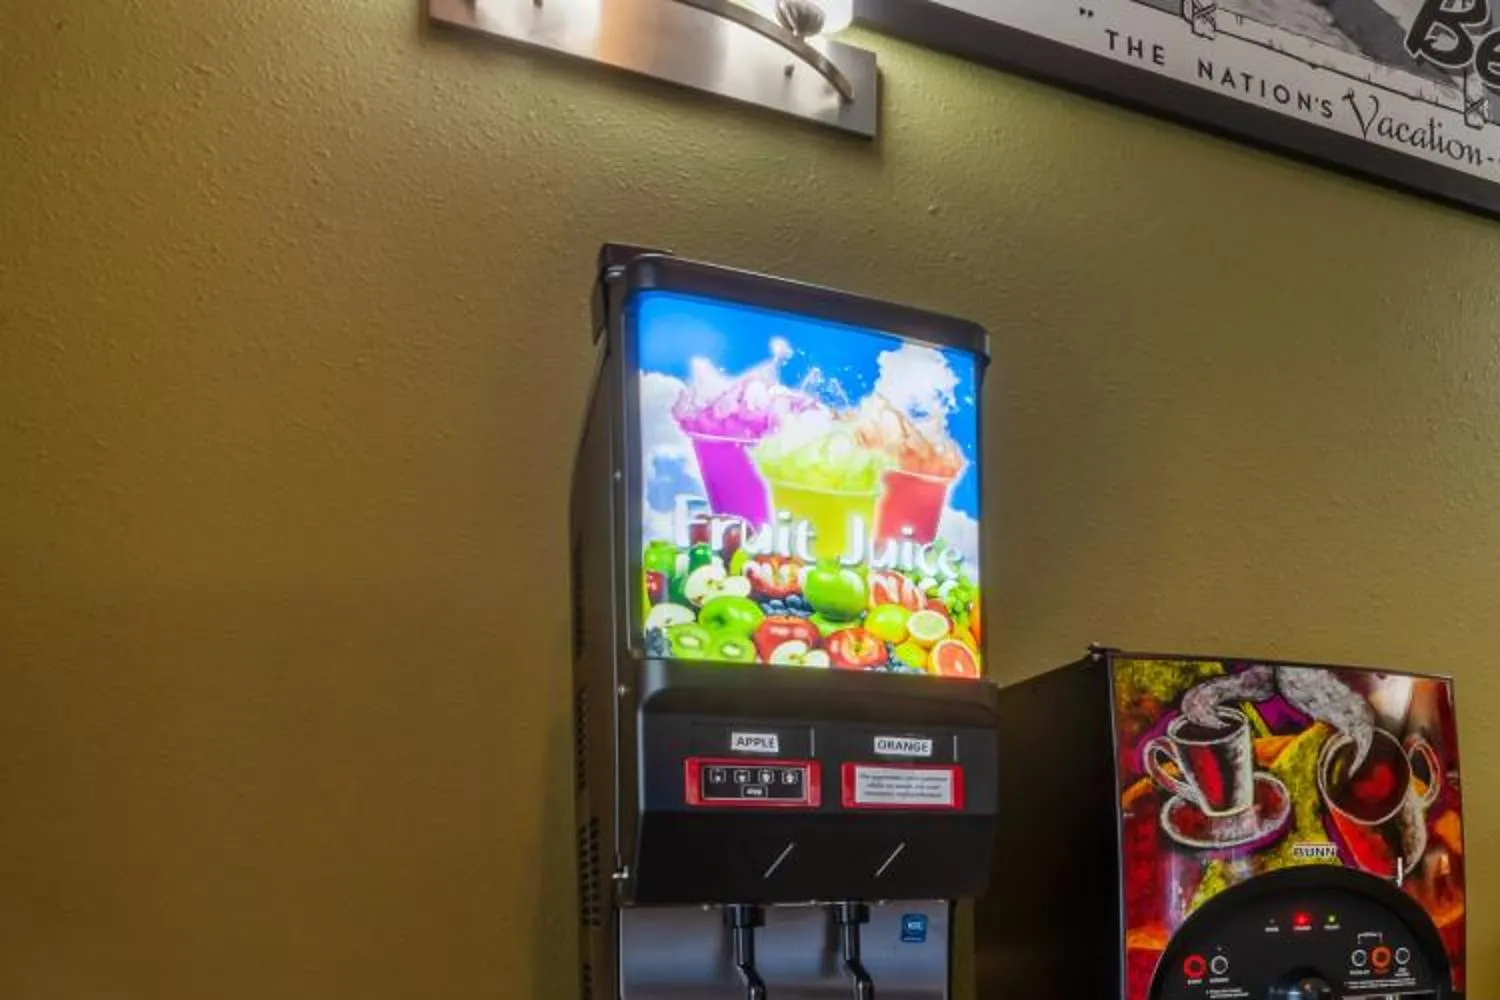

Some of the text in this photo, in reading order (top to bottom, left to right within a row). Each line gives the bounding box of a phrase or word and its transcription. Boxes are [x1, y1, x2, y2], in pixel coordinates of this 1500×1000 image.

[1196, 58, 1334, 120] NATION'S
[674, 493, 966, 577] Fruit Juice
[735, 735, 778, 749] APPLE
[877, 739, 930, 753] ORANGE
[1293, 846, 1335, 857] BUNN
